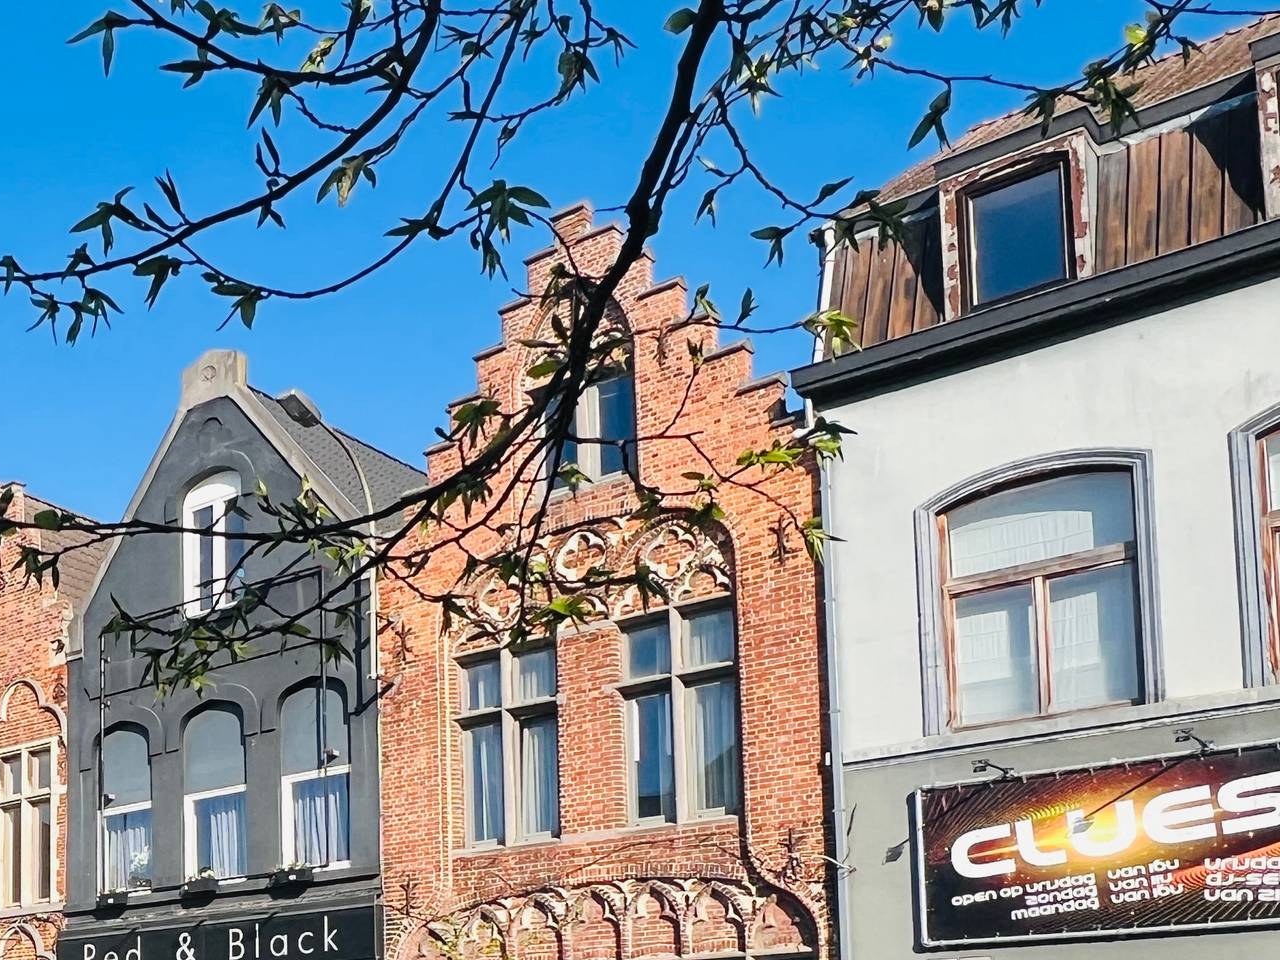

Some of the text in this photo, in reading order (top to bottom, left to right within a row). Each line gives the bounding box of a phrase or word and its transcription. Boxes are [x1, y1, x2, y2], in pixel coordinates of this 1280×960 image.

[951, 771, 1280, 878] CLUES
[1204, 855, 1280, 870] vrijda
[1000, 885, 1023, 898] op
[1107, 865, 1147, 880] van
[1024, 884, 1098, 906] zondag
[1108, 876, 1148, 891] van
[1204, 888, 1254, 901] van
[1011, 898, 1099, 920] maandag
[1110, 889, 1150, 904] van
[228, 915, 339, 960] Black
